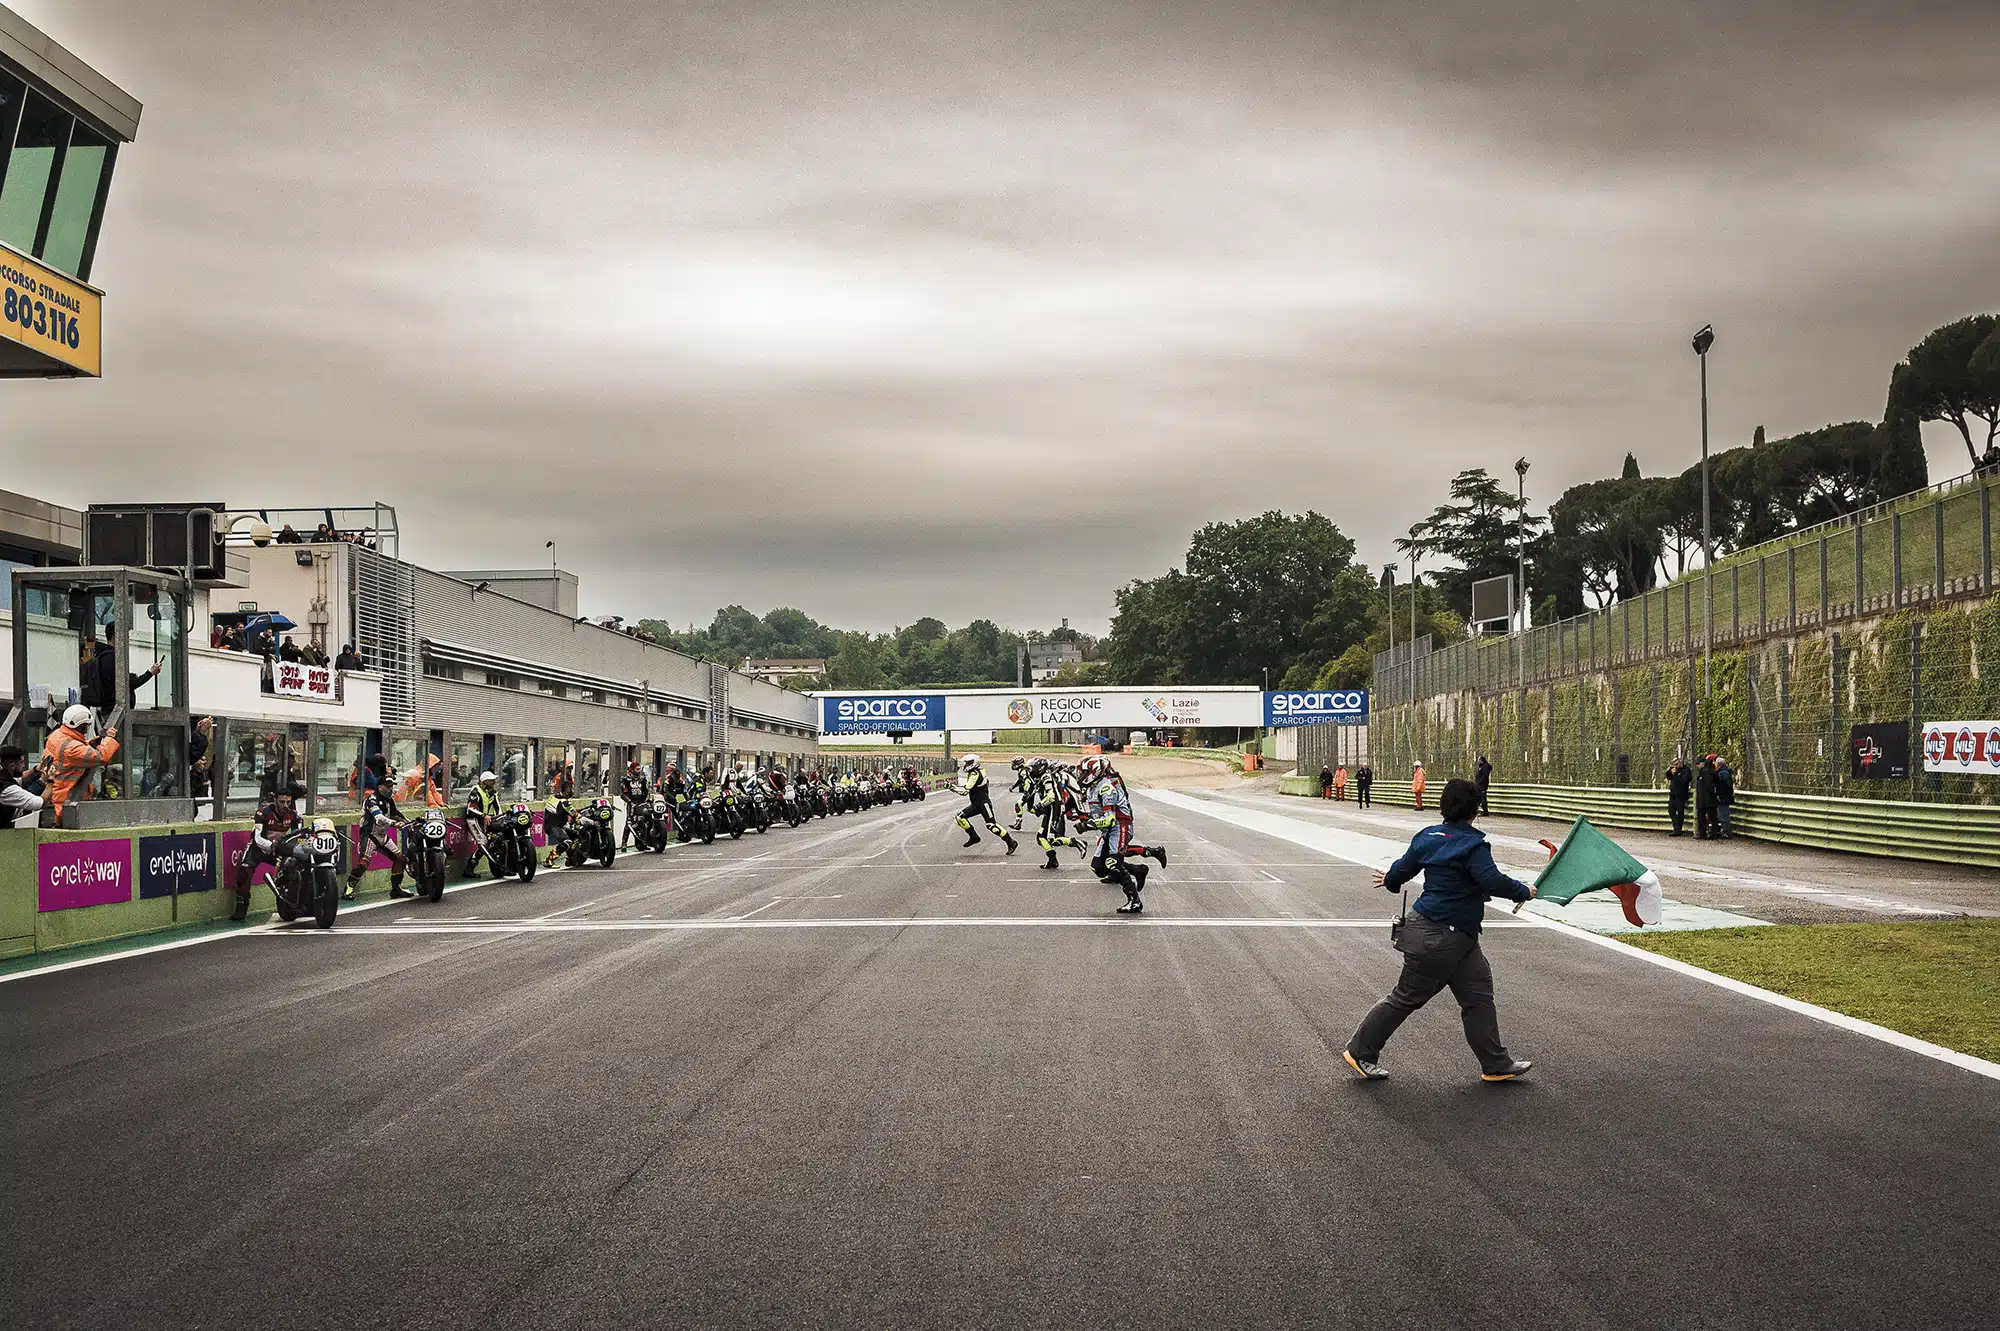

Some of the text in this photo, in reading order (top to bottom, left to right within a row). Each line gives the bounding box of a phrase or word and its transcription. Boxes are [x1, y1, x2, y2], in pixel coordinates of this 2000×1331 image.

[0, 264, 80, 314] CCORSO STRADALE
[4, 287, 80, 349] 803.116
[1040, 698, 1101, 709] REGIONE
[1272, 692, 1362, 715] sparco
[838, 700, 926, 721] sparco
[1040, 711, 1083, 723] LAZIO
[838, 722, 926, 730] SPARCO-OFFICIAL.COM
[1925, 740, 1945, 753] NILS
[1956, 740, 1975, 753] NILS
[428, 825, 443, 836] 28
[316, 837, 334, 849] 910
[149, 850, 175, 876] enel
[50, 858, 121, 887] enel way
